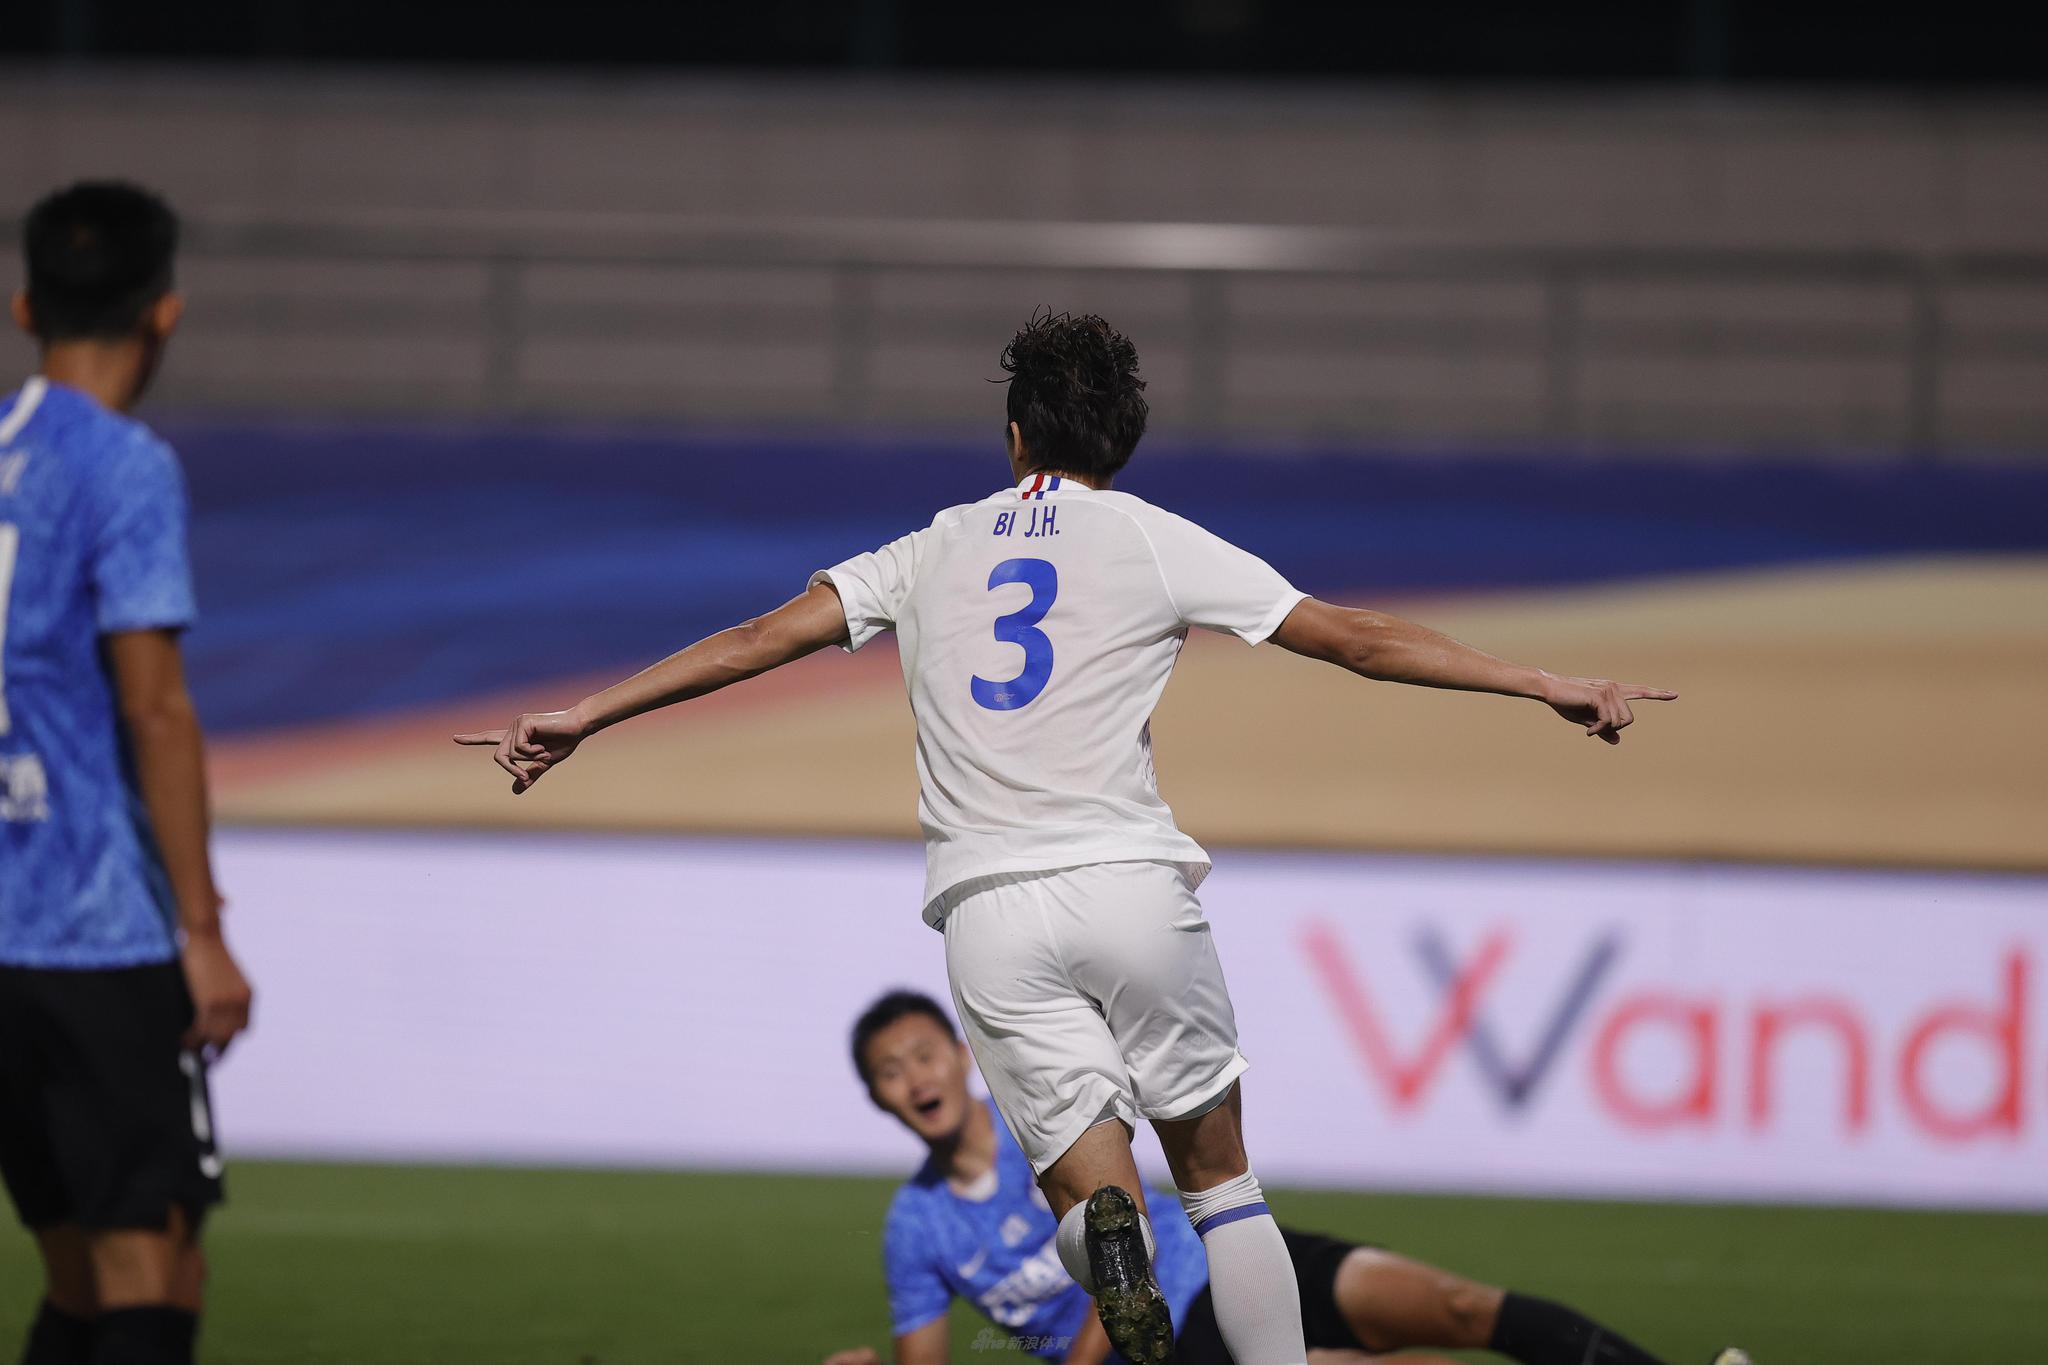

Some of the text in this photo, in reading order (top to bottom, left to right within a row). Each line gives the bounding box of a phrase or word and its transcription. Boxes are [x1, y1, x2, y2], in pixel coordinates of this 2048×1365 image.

[993, 505, 1060, 537] BI J.H.
[970, 557, 1058, 711] 3
[1298, 917, 2048, 1143] Wand
